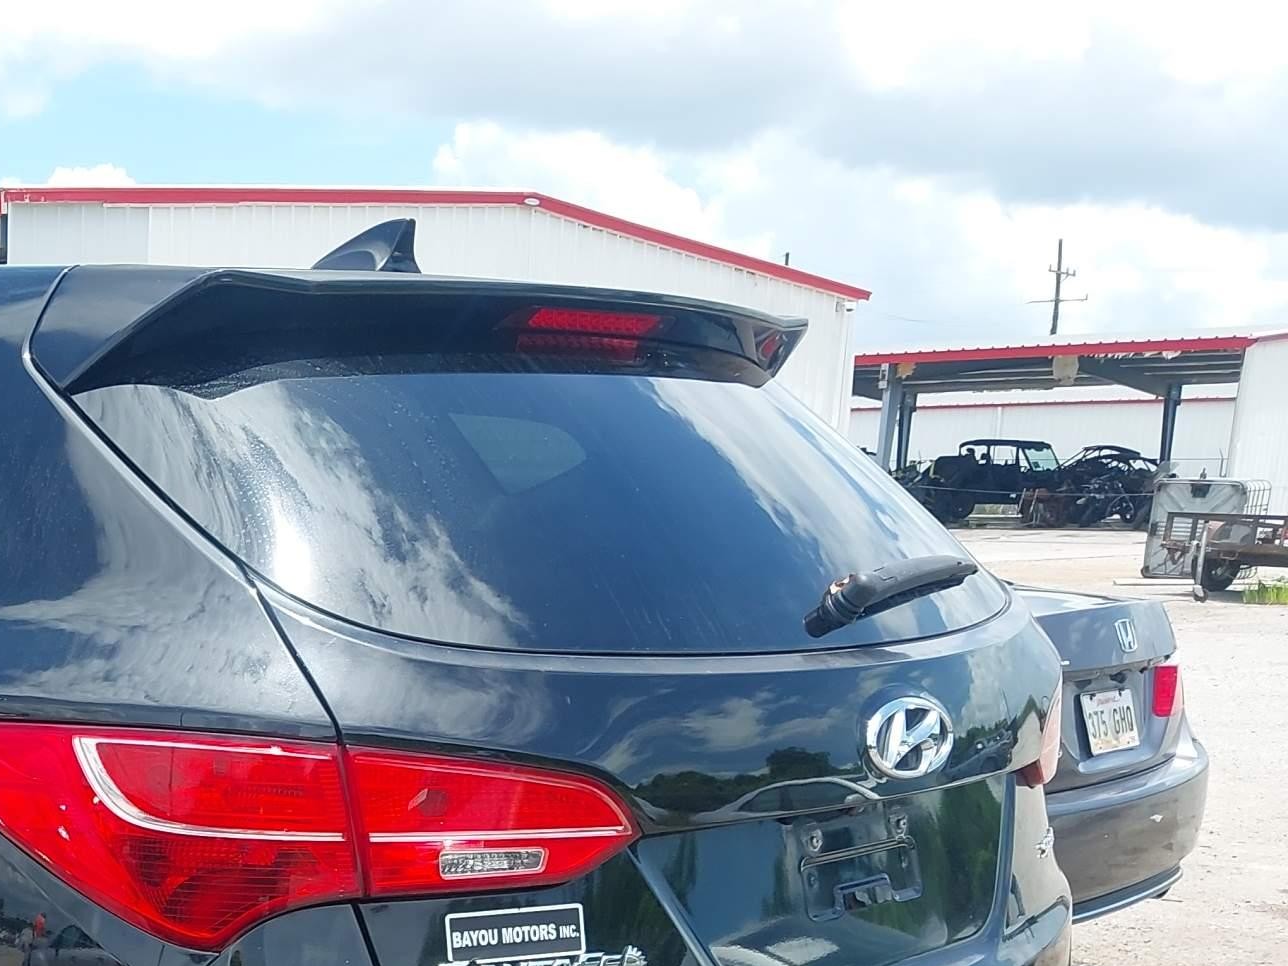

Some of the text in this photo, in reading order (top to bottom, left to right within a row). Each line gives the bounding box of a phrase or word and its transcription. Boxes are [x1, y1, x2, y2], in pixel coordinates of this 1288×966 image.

[452, 923, 580, 949] BAYOU MOTORS INC.
